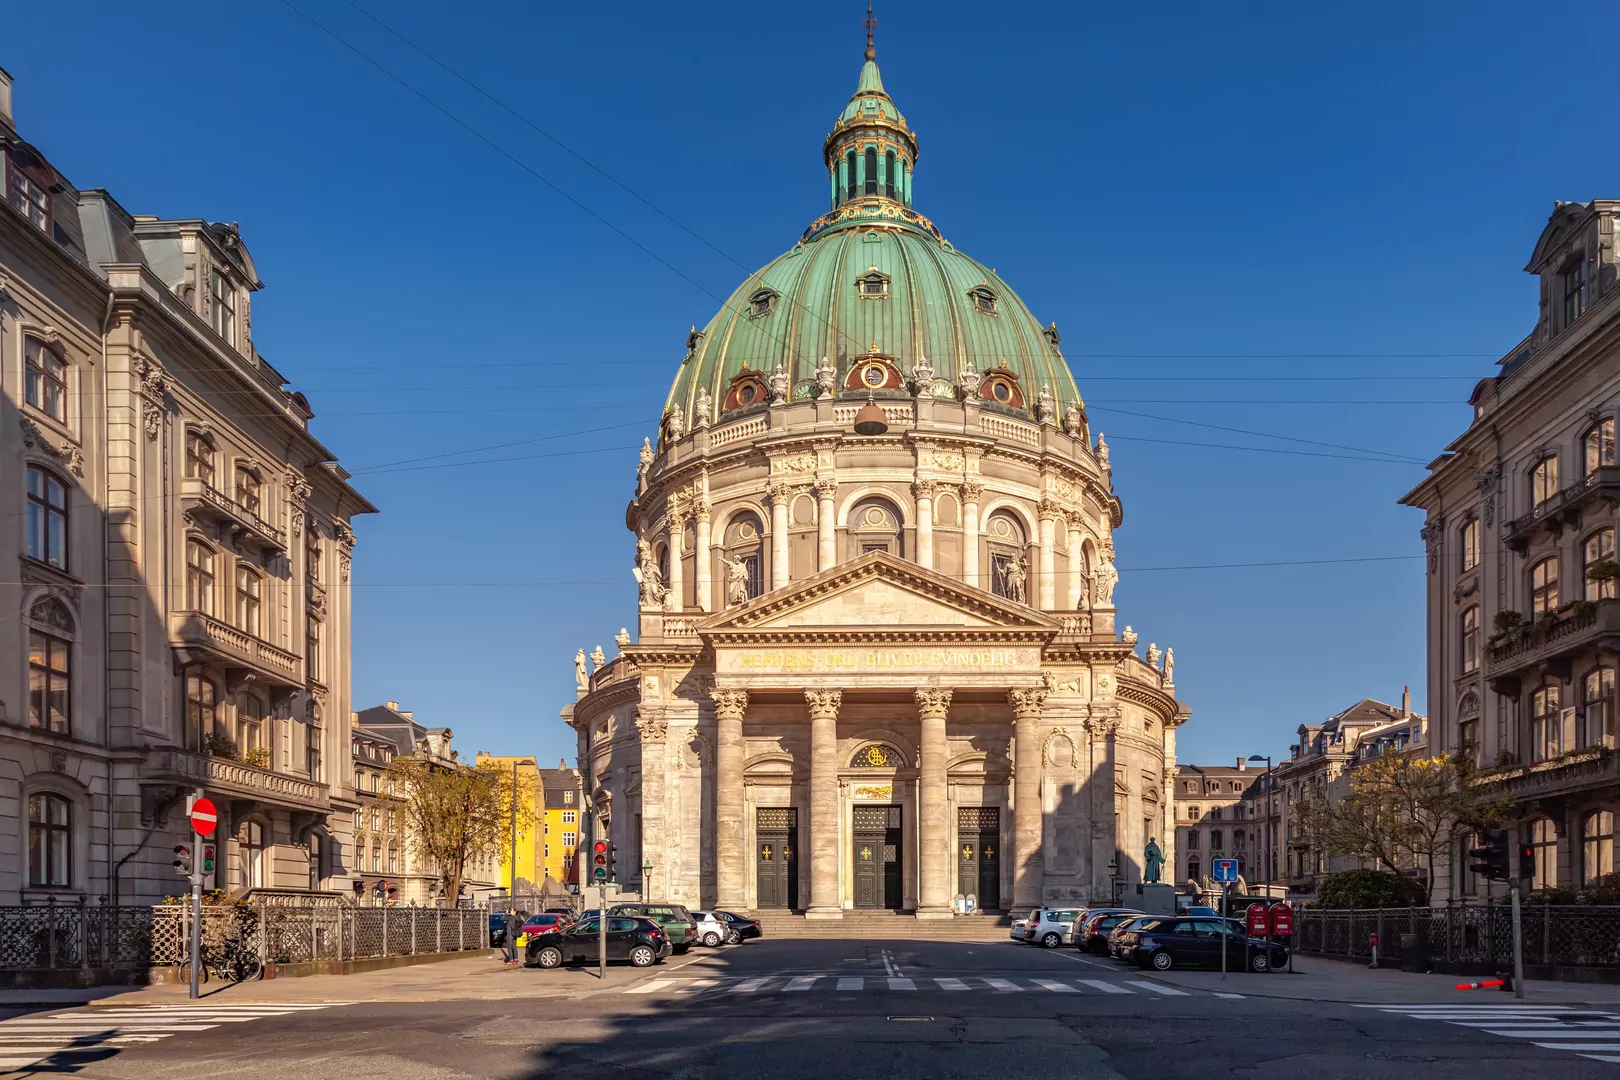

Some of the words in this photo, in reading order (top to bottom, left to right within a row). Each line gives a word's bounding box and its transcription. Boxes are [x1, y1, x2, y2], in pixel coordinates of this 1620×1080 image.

[740, 653, 817, 668] HERRENS
[824, 653, 858, 668] ORD
[865, 653, 923, 667] BLIVER
[931, 652, 1017, 667] EVINDELIG
